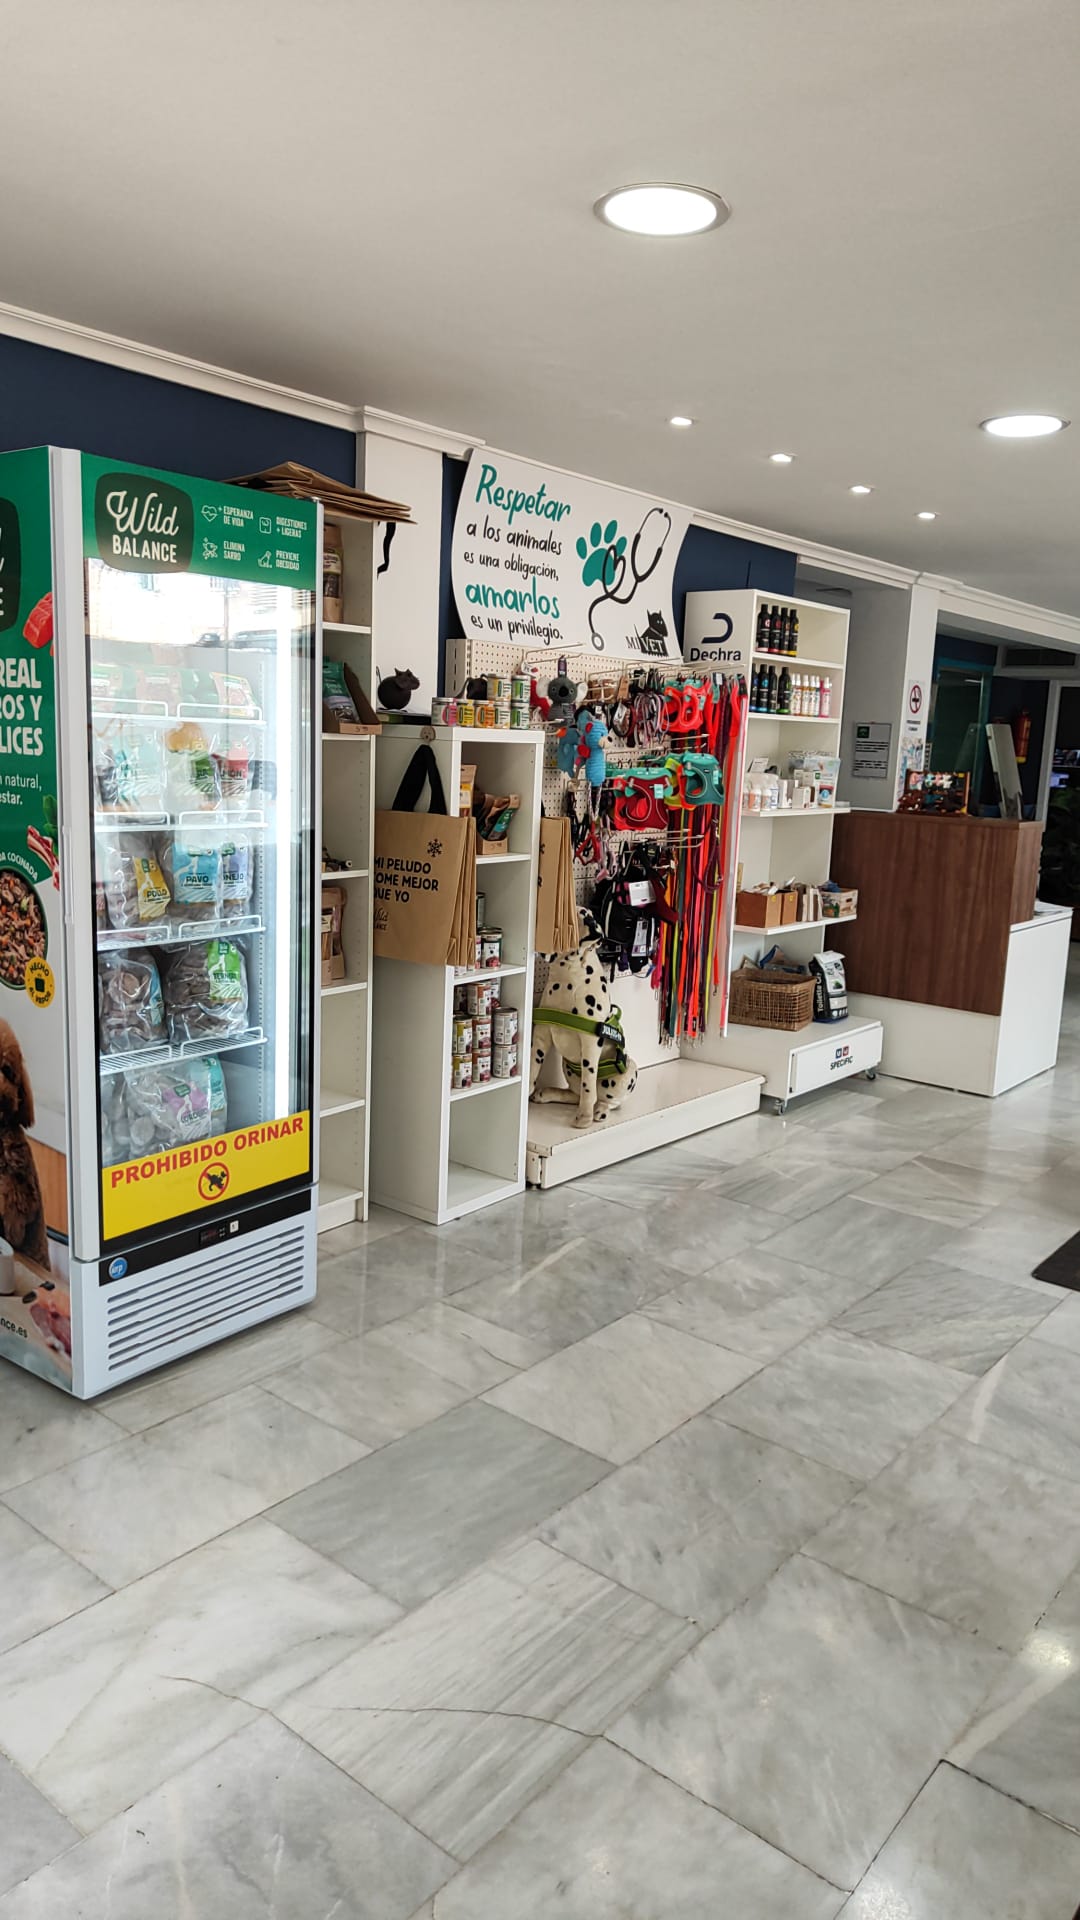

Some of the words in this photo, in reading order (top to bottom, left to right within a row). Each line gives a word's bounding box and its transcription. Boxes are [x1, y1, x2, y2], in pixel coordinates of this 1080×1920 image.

[475, 463, 571, 525] Respetar
[106, 490, 179, 535] Wild
[223, 505, 254, 520] ESPERANZA
[223, 515, 232, 525] DE
[232, 517, 244, 527] VIDA
[276, 516, 307, 531] DIGESTIONES
[281, 528, 302, 538] LIGERAS
[466, 523, 477, 537] a
[483, 515, 501, 542] los
[506, 530, 562, 556] animales
[111, 533, 178, 564] BALANCE
[223, 540, 246, 552] ELIMINA
[223, 550, 242, 561] SARRO
[275, 550, 300, 561] PREVIENE
[275, 559, 300, 570] OBESIDAD
[463, 551, 475, 564] es
[479, 552, 500, 568] una
[504, 558, 559, 582] obligación,
[465, 576, 560, 620] amarlos
[470, 614, 484, 629] es
[487, 619, 503, 632] un
[508, 620, 564, 646] privilegio.
[690, 648, 742, 661] Dechra
[30, 695, 43, 721] Y
[5, 773, 42, 792] natural,
[7, 851, 38, 881] COCINADA
[386, 858, 431, 875] PELUDO
[186, 875, 209, 883] PAVO
[374, 870, 399, 887] OME
[401, 875, 439, 892] MEJOR
[395, 890, 410, 904] YO
[111, 1139, 227, 1189] PROHIBIDO
[233, 1116, 304, 1151] ORINAR
